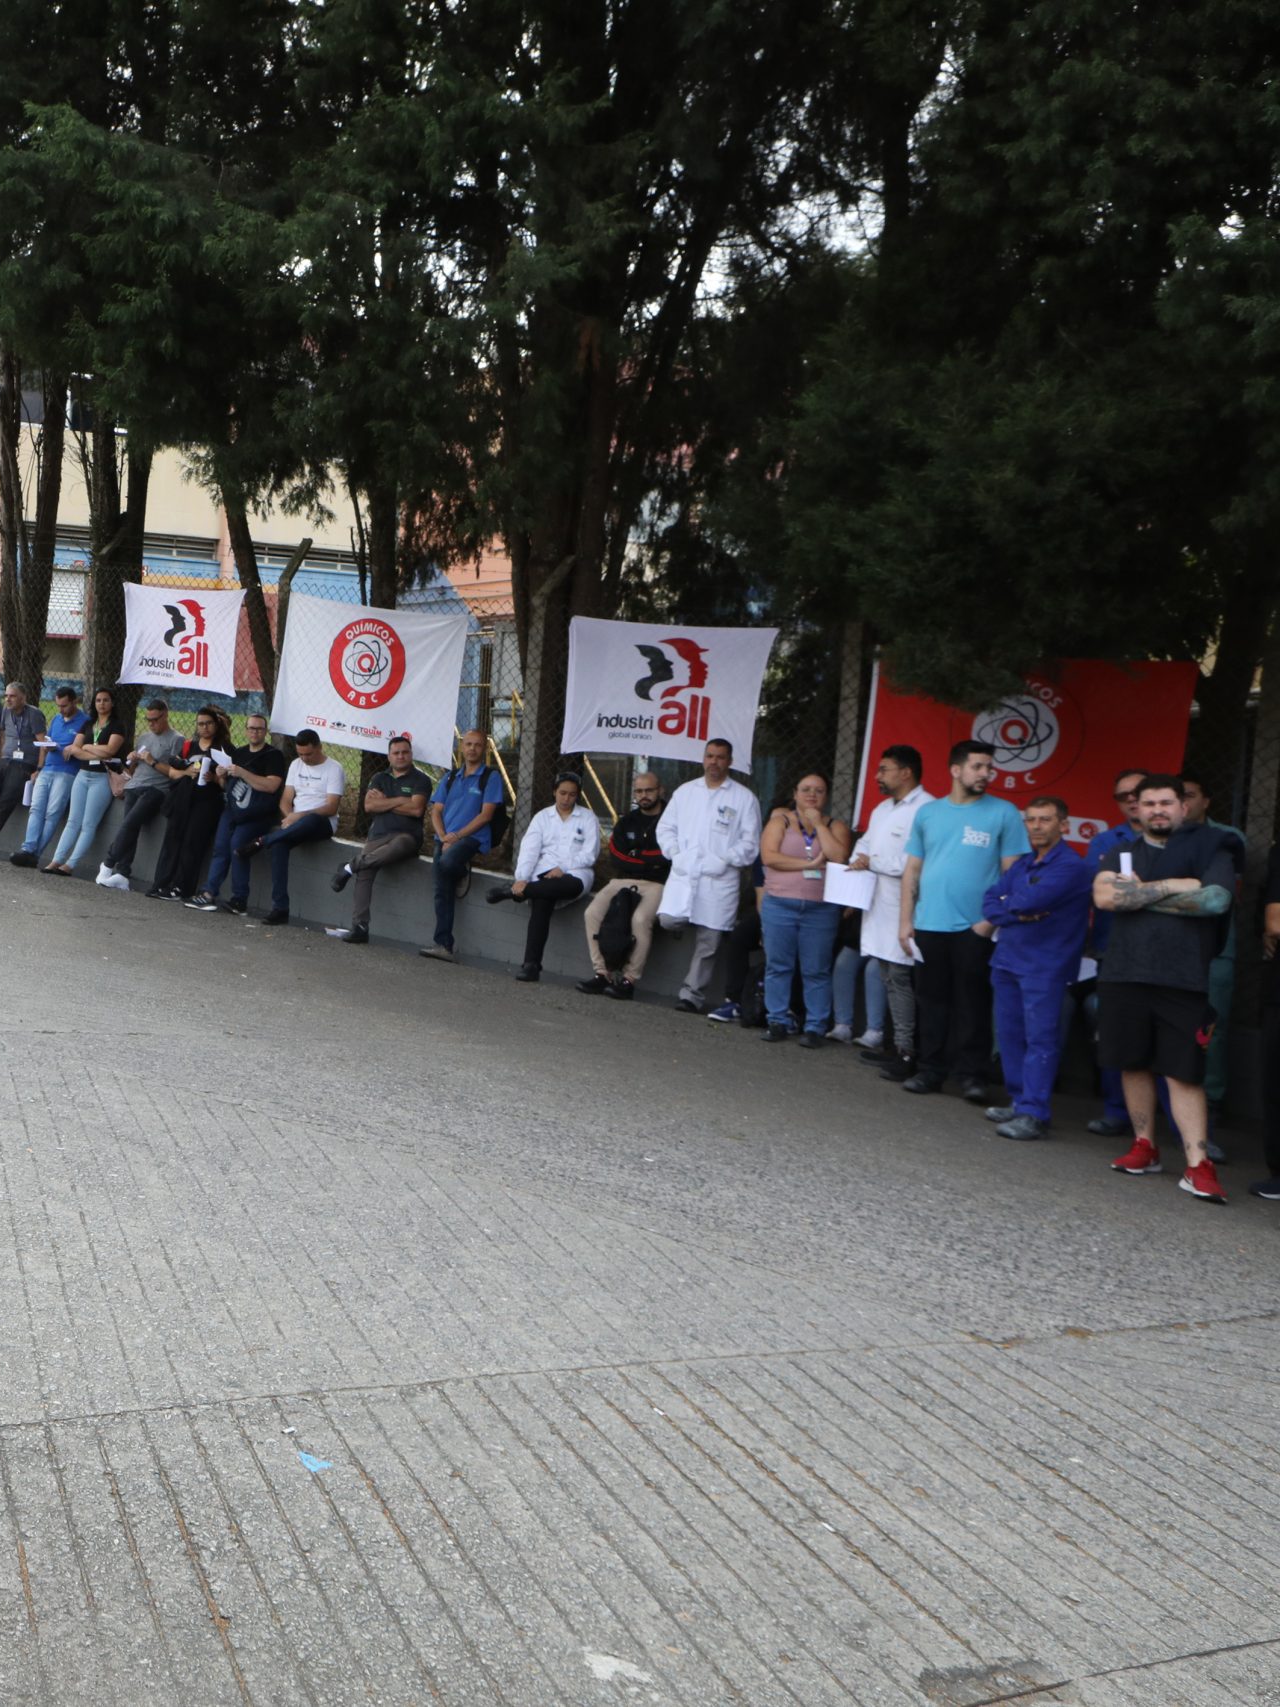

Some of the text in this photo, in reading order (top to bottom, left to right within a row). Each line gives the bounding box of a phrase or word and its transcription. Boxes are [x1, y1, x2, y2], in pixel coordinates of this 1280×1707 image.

[345, 621, 395, 647] QUÍMICOS
[608, 730, 652, 741] global union
